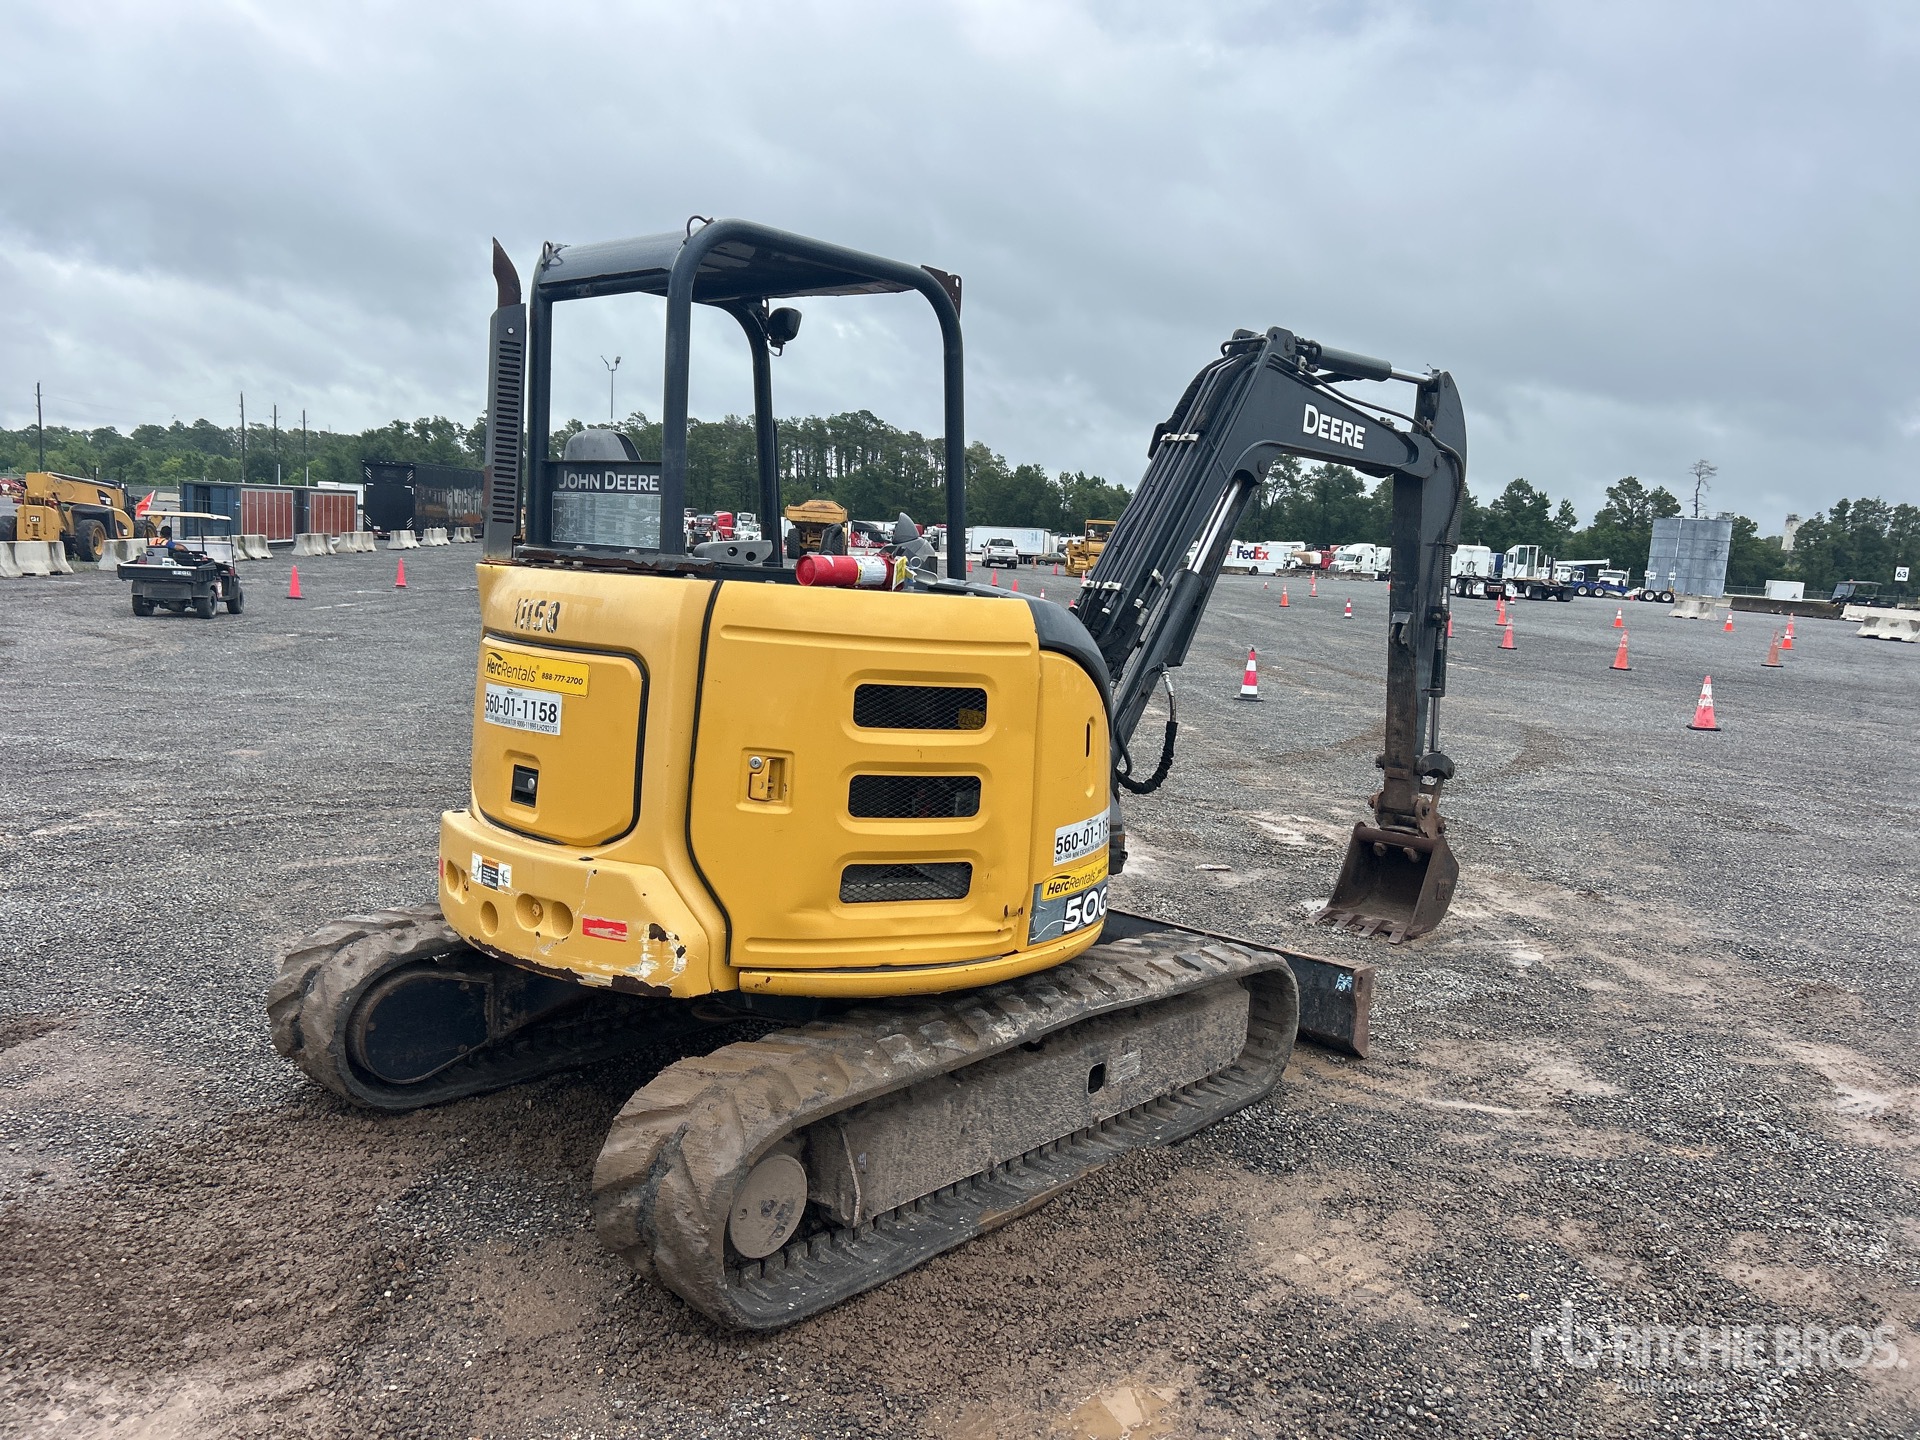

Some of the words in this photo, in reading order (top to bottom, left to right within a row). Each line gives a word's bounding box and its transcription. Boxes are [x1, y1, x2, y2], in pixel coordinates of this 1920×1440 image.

[1302, 403, 1366, 450] DEERE
[558, 470, 600, 490] JOHN
[604, 470, 660, 491] DEERE
[1236, 545, 1269, 561] FedEx
[485, 692, 558, 724] 560-01-1158
[1063, 886, 1107, 933] 50G
